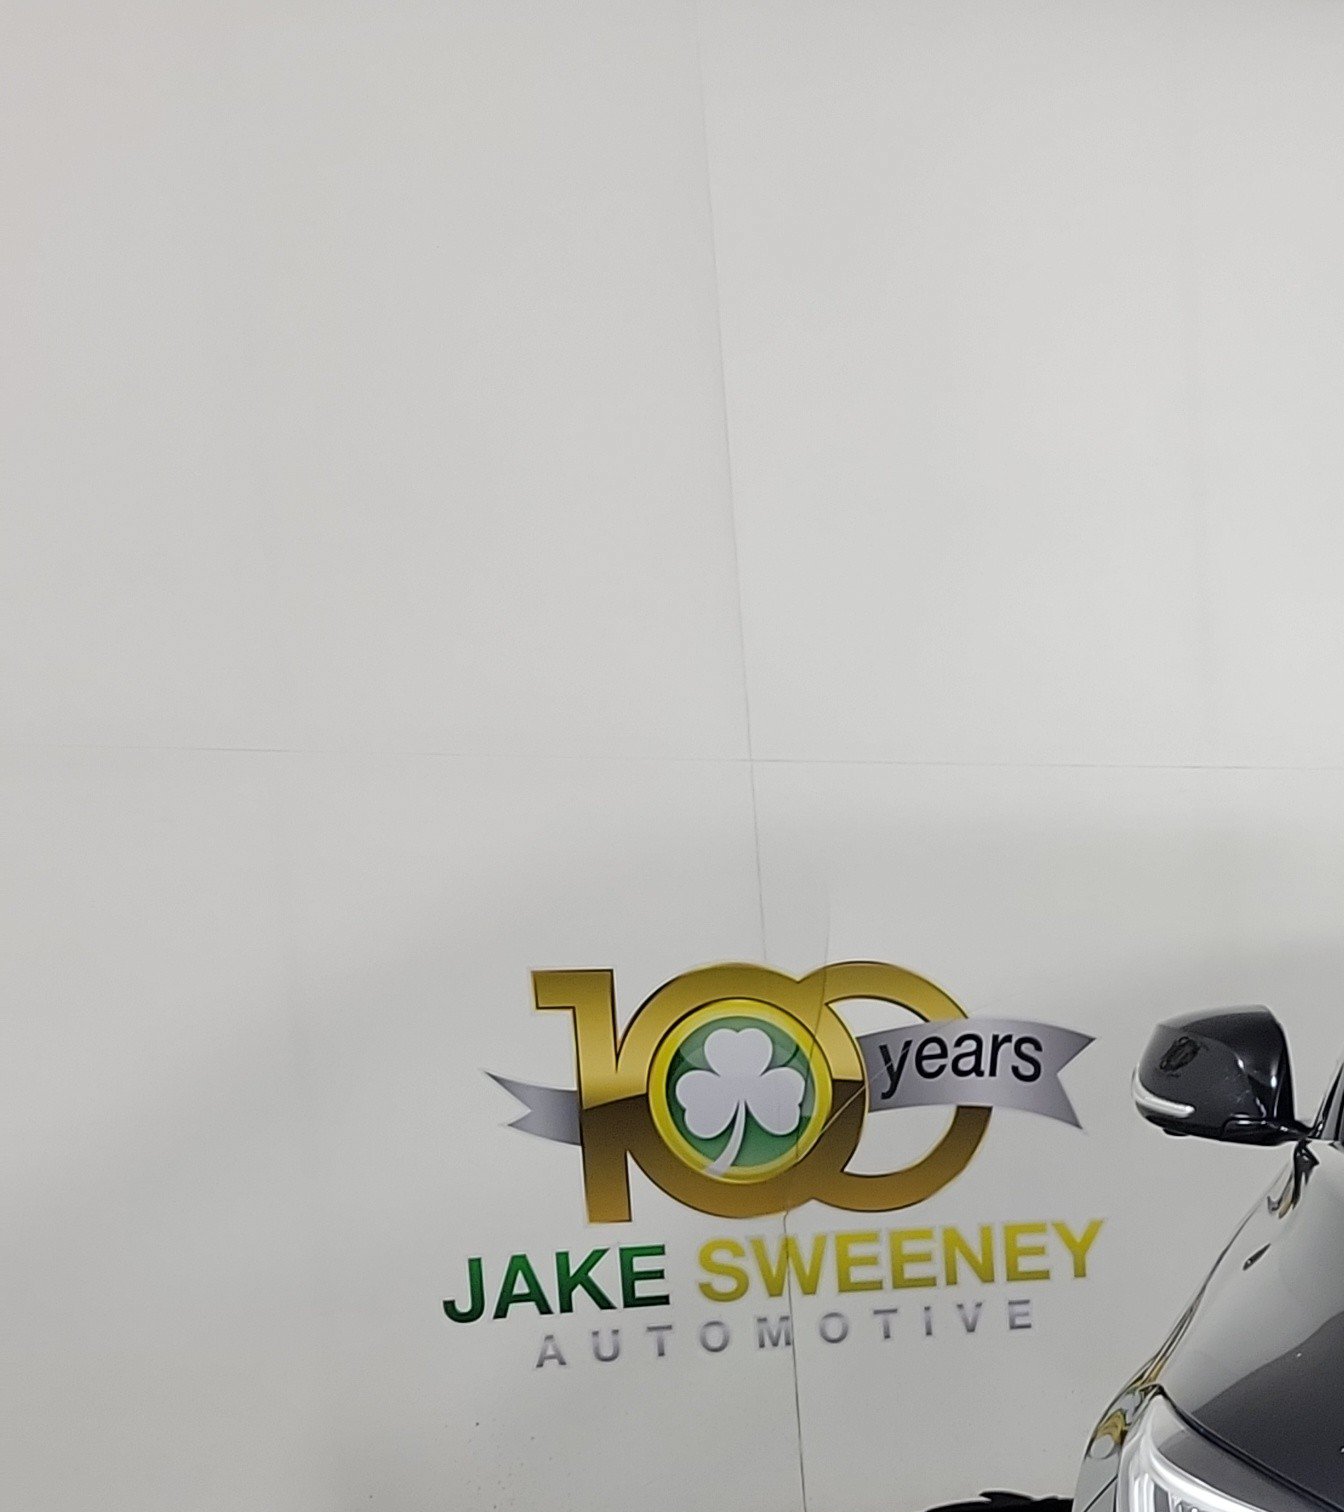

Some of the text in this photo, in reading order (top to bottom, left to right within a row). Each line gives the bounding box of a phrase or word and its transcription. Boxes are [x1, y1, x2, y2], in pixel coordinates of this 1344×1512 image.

[880, 1032, 1043, 1099] years
[443, 1219, 1103, 1323] JAKE SWEENEY
[535, 1300, 1033, 1369] AUTOMOTIVE
